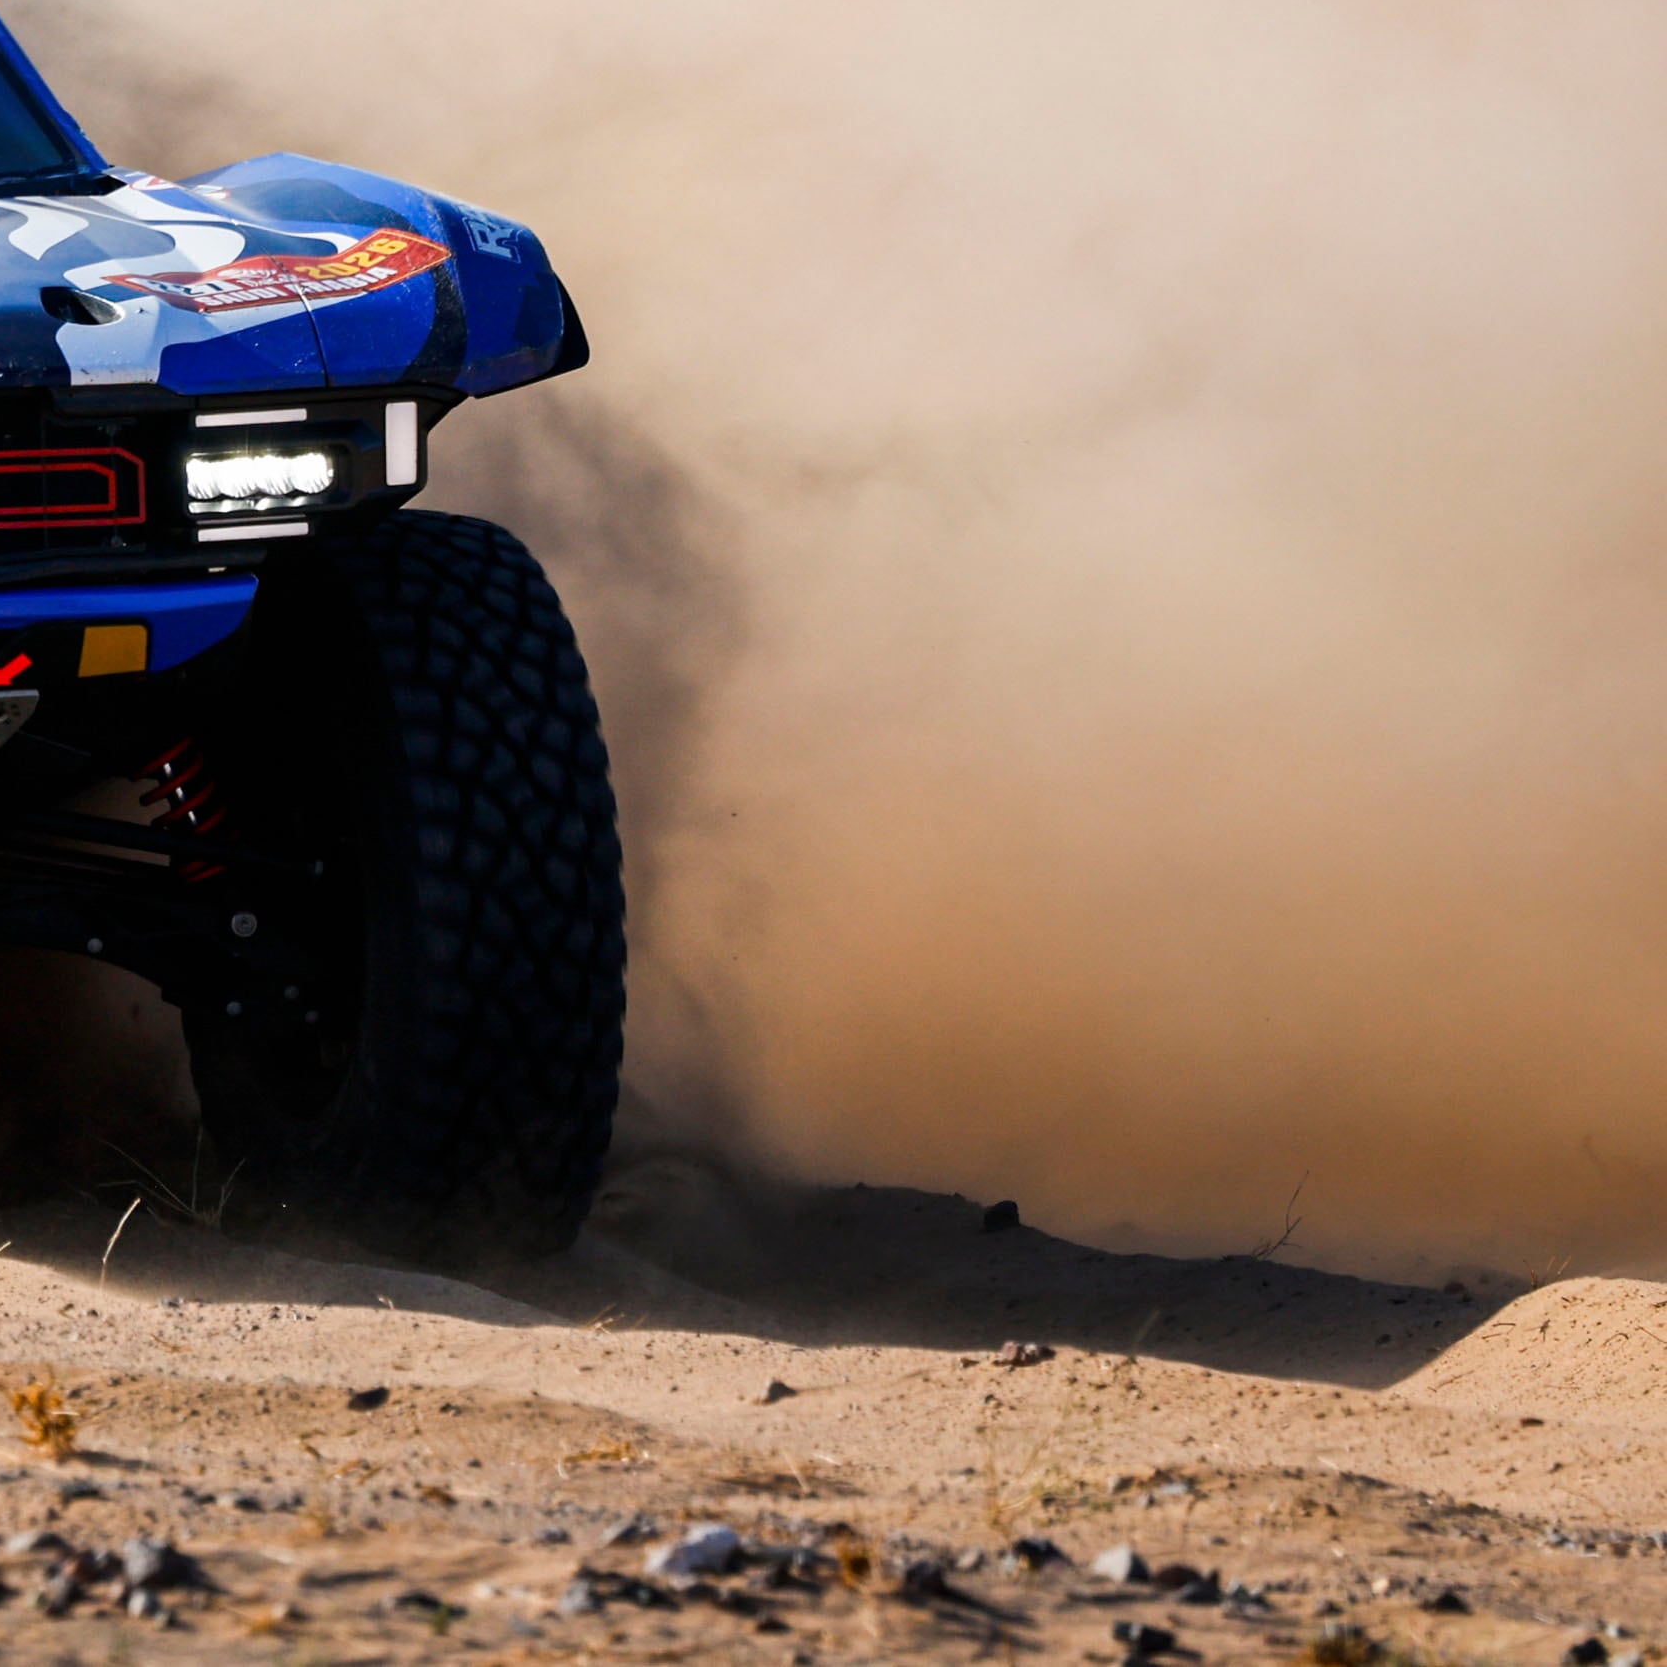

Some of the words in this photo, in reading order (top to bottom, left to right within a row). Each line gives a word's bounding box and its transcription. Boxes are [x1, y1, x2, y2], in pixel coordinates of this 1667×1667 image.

[294, 238, 409, 281] 2026
[194, 287, 289, 307] SAUDI
[285, 266, 400, 295] ARABIA
